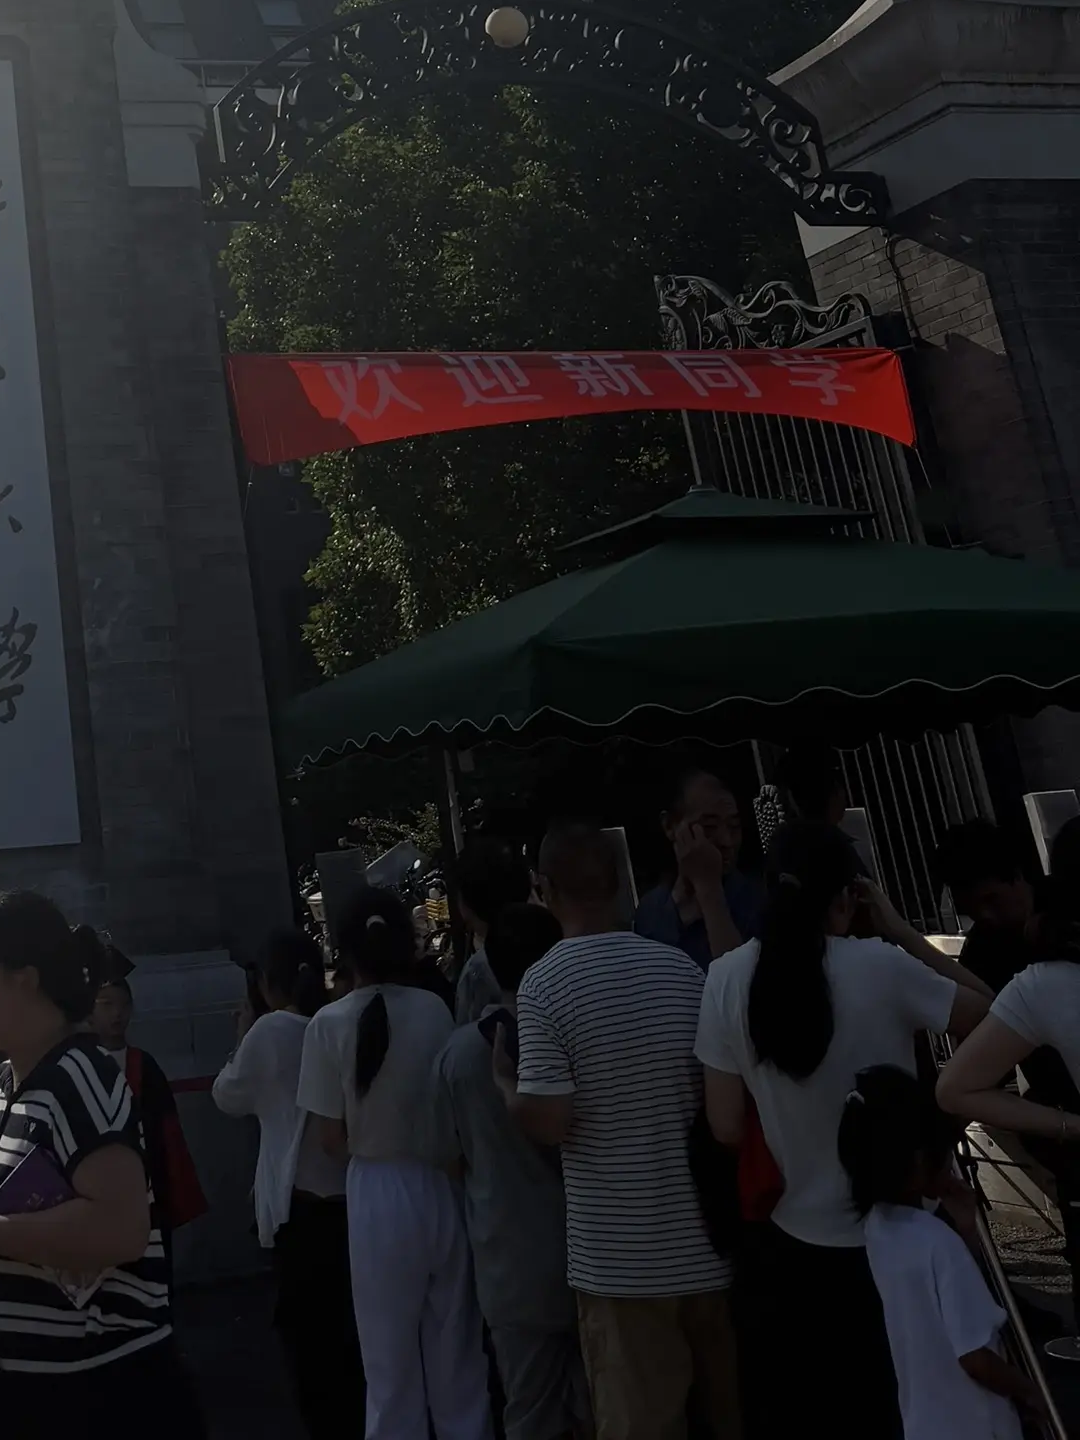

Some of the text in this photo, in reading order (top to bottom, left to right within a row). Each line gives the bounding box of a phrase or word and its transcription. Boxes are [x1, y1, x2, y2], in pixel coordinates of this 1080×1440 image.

[319, 352, 857, 426] 欢迎新同学
